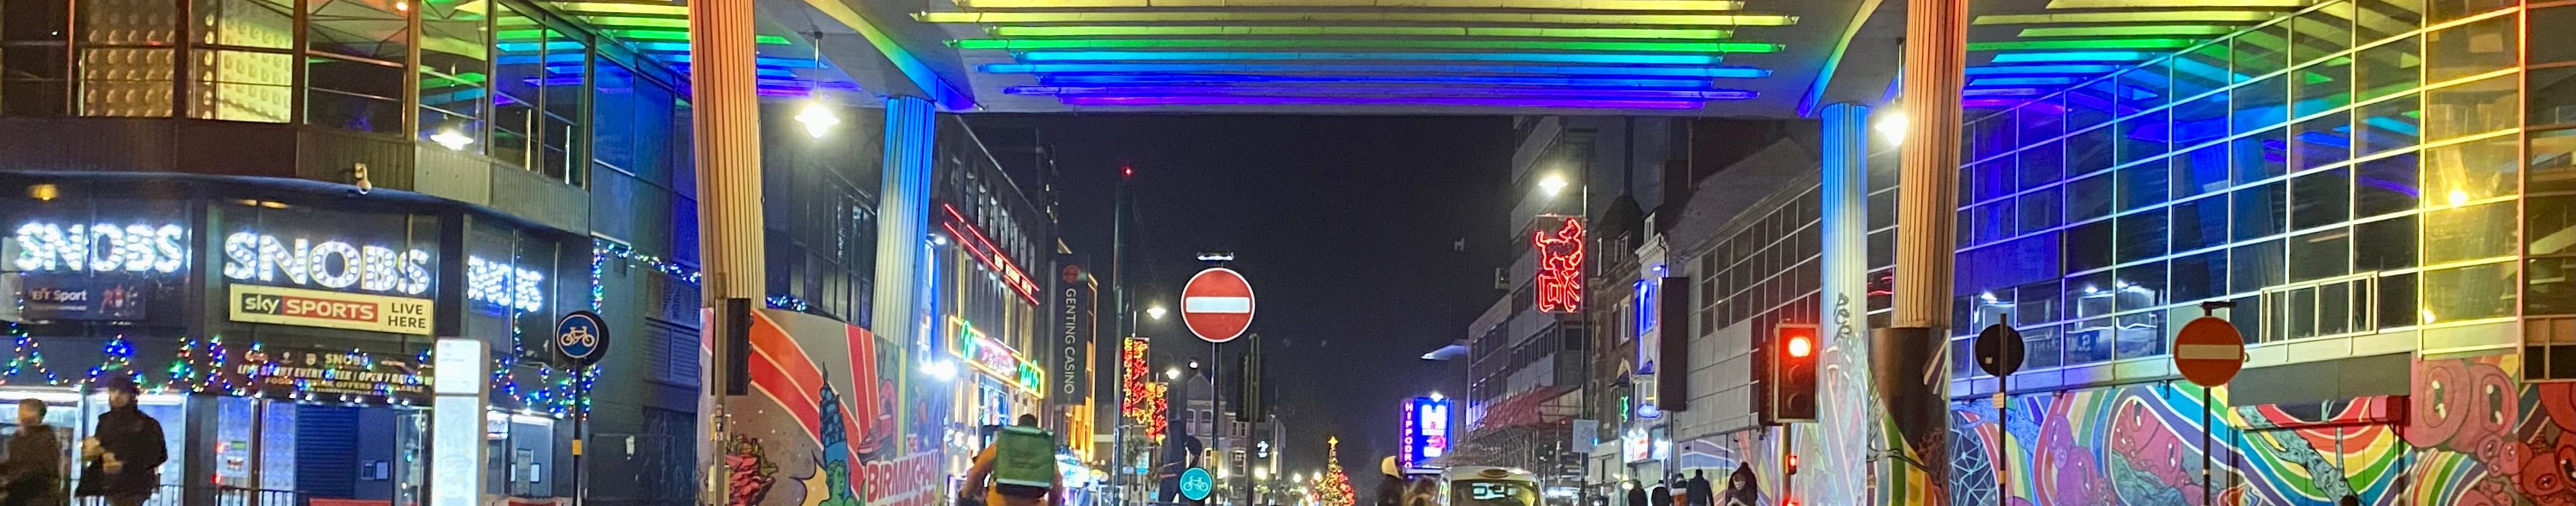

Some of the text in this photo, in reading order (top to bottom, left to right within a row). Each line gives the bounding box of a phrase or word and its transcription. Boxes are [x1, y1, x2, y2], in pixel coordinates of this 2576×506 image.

[16, 223, 183, 273] SNOBS
[224, 232, 430, 295] SNOBS
[53, 289, 87, 302] Sport
[245, 295, 375, 320] sky SPORTS
[391, 302, 424, 315] LIVE
[387, 316, 427, 329] HERE
[1064, 288, 1077, 394] GENTING CASINO
[867, 453, 938, 503] BIRMINGHAM
